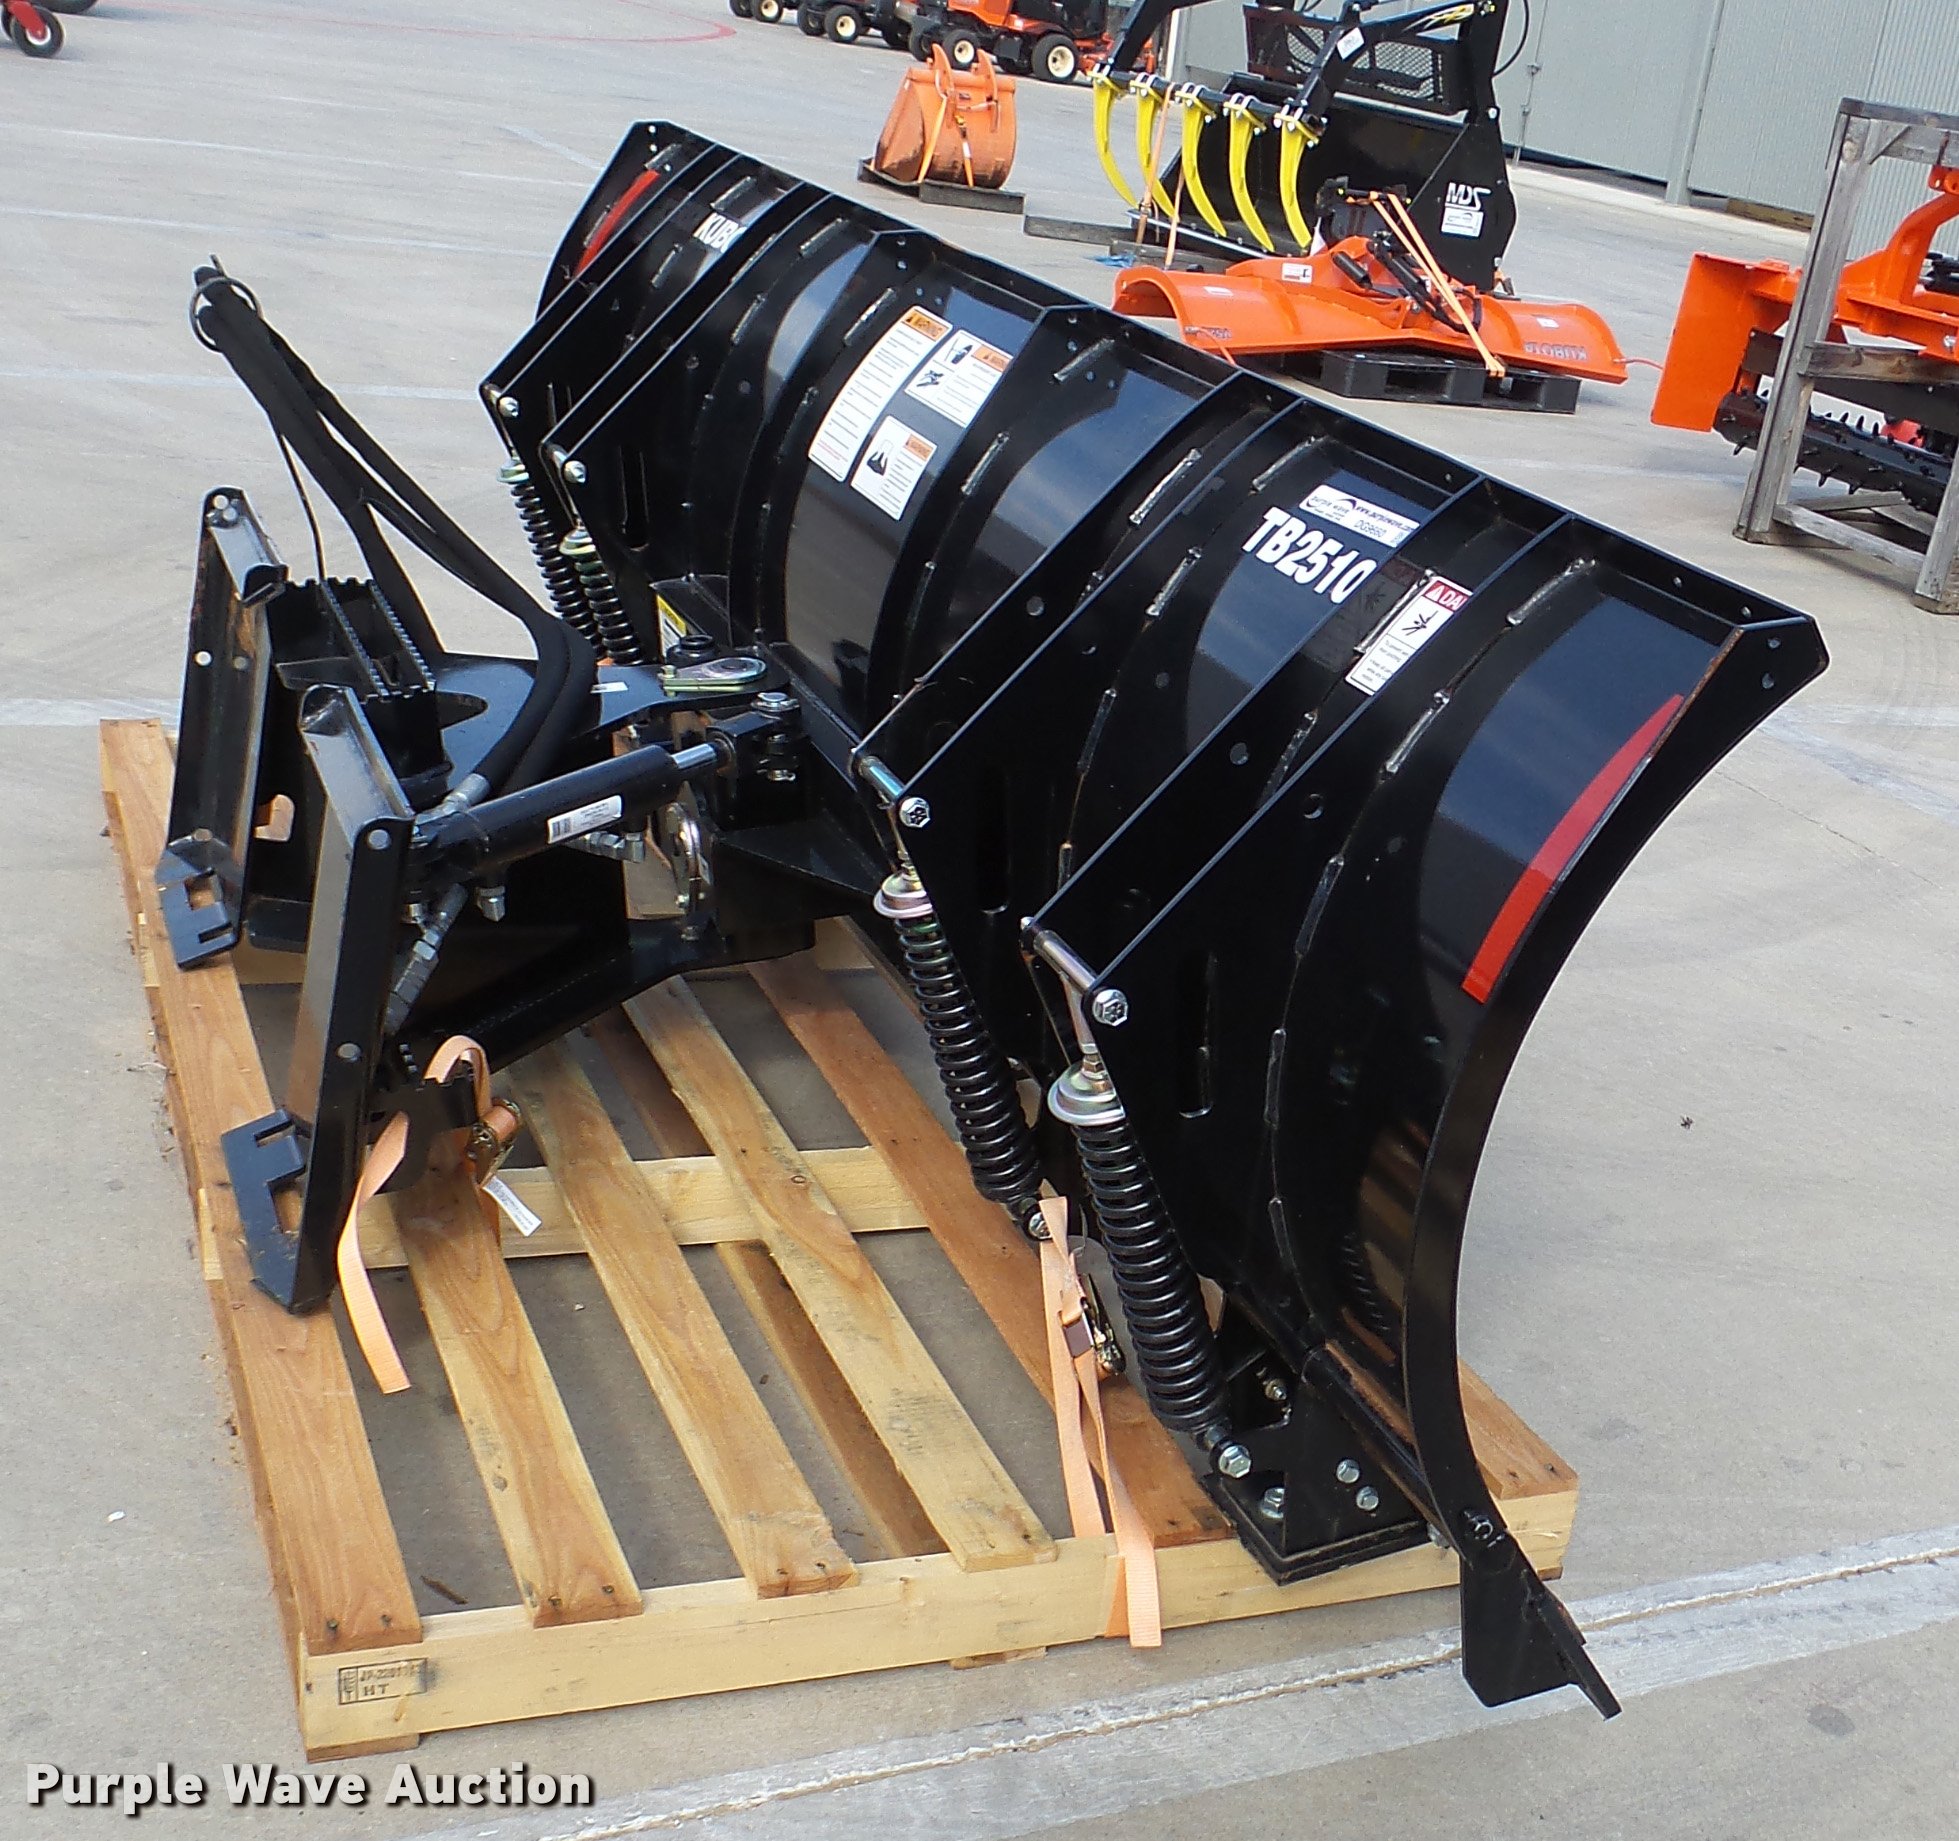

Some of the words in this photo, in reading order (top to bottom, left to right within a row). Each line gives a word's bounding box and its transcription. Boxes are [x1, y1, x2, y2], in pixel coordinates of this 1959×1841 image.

[1445, 182, 1491, 211] MDS
[1242, 506, 1377, 604] TB2510
[364, 1683, 389, 1696] HT
